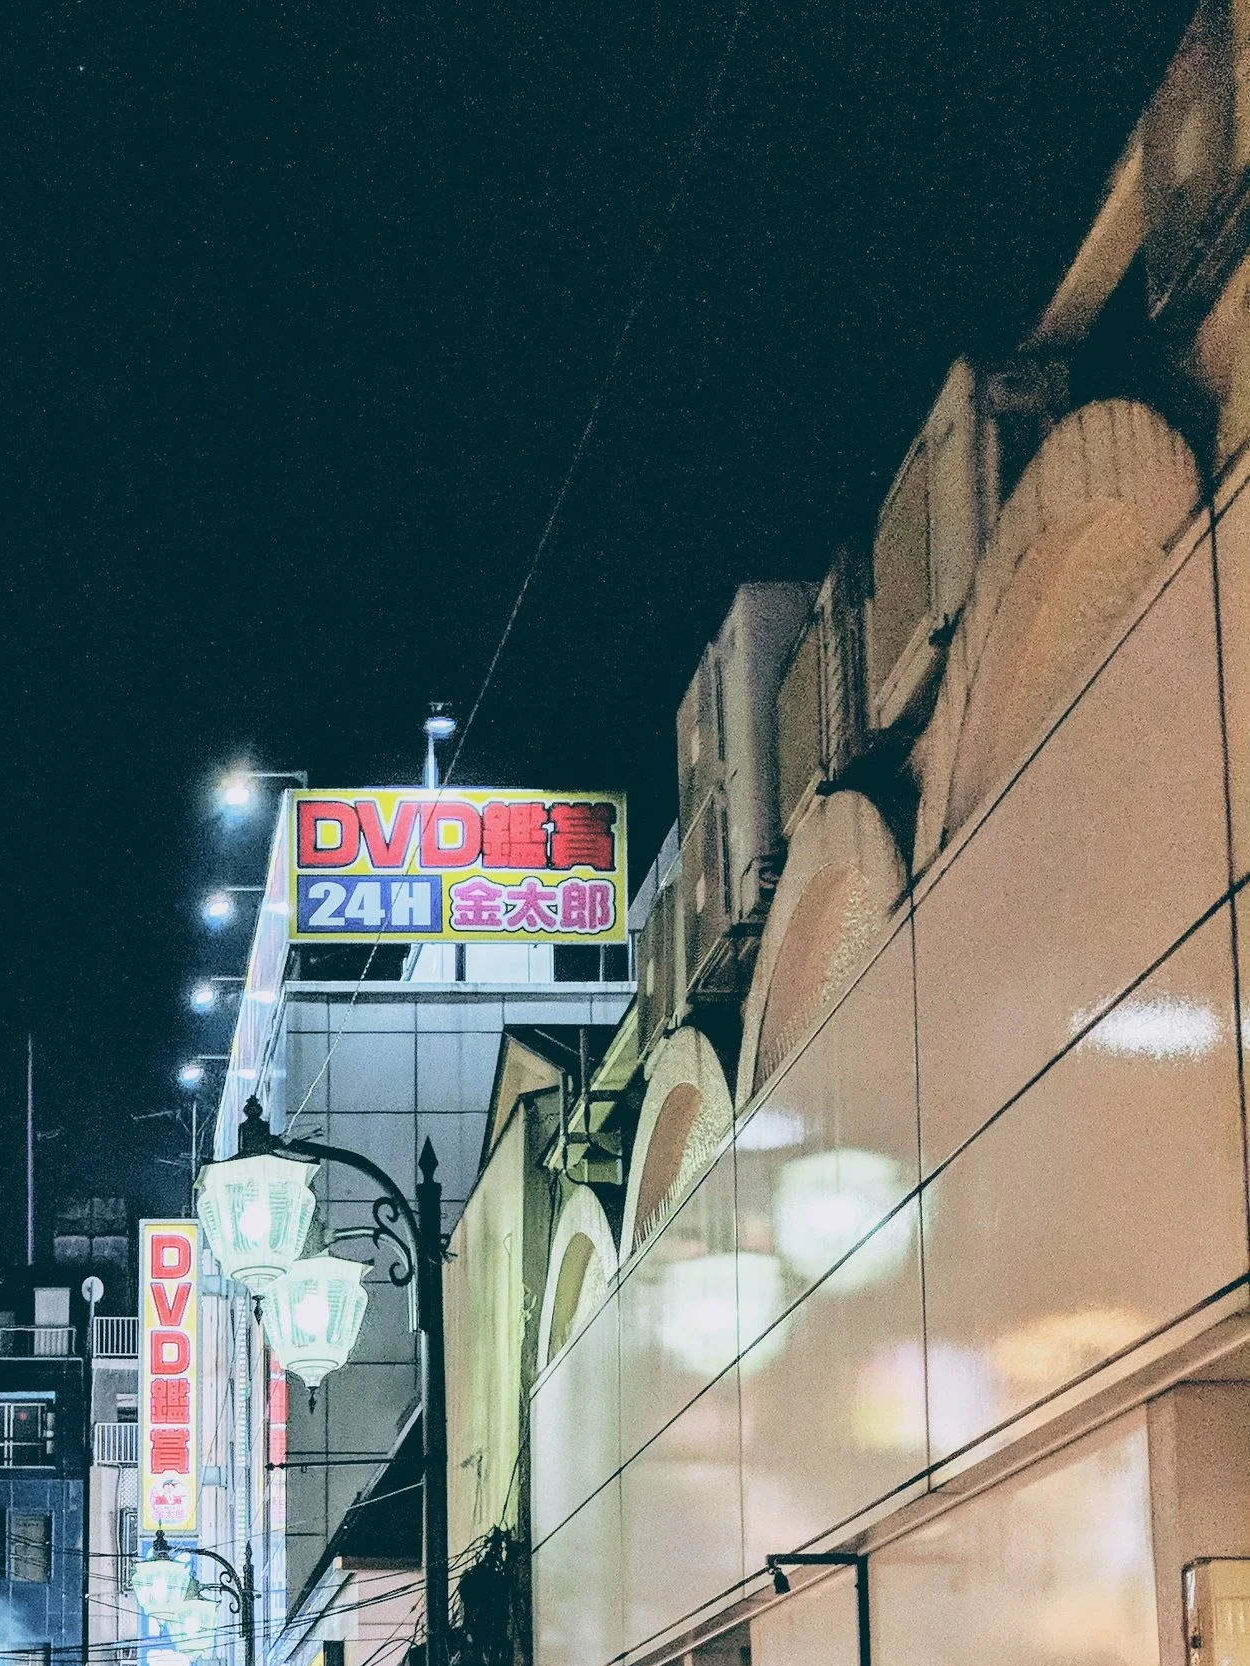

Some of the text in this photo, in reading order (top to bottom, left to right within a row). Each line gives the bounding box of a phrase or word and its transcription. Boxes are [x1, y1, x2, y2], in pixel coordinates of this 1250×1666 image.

[454, 880, 609, 930] 金太郎
[150, 1234, 192, 1475] DVD鑑賞
